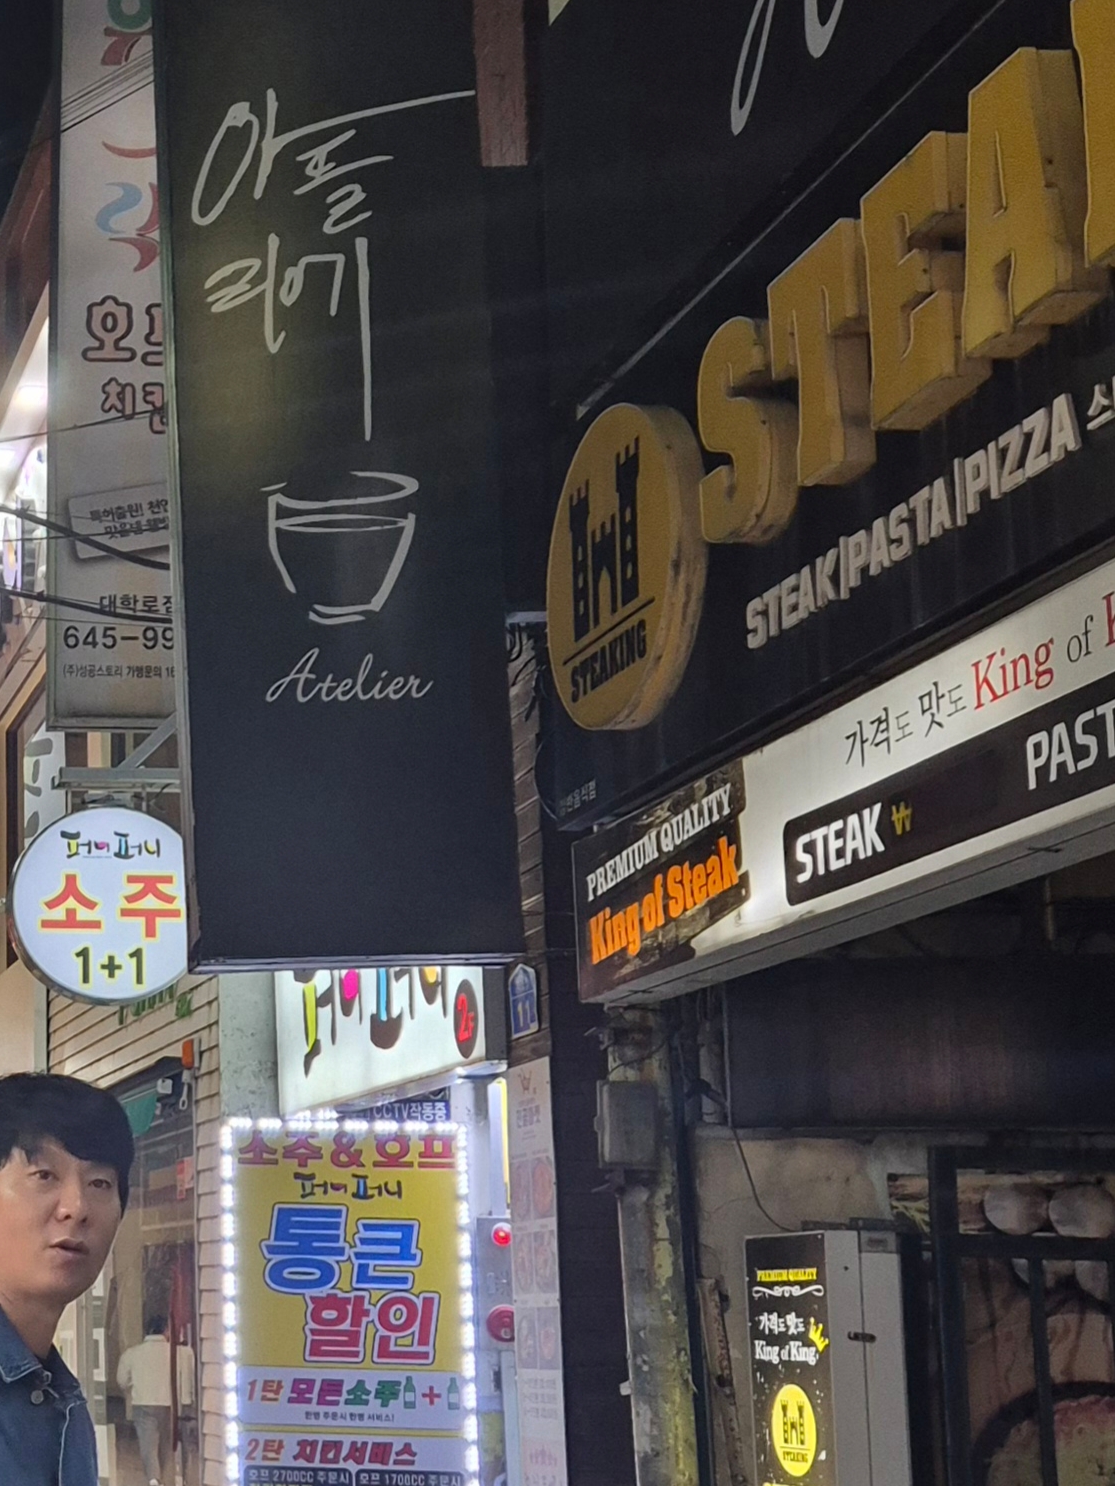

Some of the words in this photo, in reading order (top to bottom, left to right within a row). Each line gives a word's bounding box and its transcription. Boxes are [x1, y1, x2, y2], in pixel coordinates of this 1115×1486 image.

[265, 647, 434, 703] Atelier
[570, 617, 648, 704] STEAKING
[845, 706, 914, 768] 가격도
[918, 681, 968, 738] 맛도
[972, 637, 1055, 711] King
[1066, 615, 1094, 663] of
[1025, 699, 1115, 791] PAST
[586, 835, 659, 902] PREMIUM
[660, 782, 732, 852] QUALITY
[795, 801, 886, 885] STEAK
[40, 874, 183, 938] 소주
[589, 904, 641, 966] King
[642, 874, 665, 933] of
[667, 835, 739, 919] Steak
[75, 946, 146, 986] 1+1
[457, 992, 475, 1043] 2F
[261, 1203, 423, 1295] 통큰
[305, 1289, 440, 1365] 할인
[759, 1311, 786, 1335] 가격도
[786, 1311, 805, 1335] 맛도
[754, 1340, 780, 1364] King
[247, 1379, 284, 1403] 1탄
[287, 1378, 402, 1407] 모든소주
[367, 1412, 395, 1423] 서비스!
[245, 1438, 284, 1462] 2탄
[292, 1439, 418, 1467] 치킨서비스
[248, 1469, 271, 1482] 호프
[273, 1469, 314, 1483] 2700CC
[316, 1471, 350, 1485] 주문시
[359, 1474, 381, 1486] 호프
